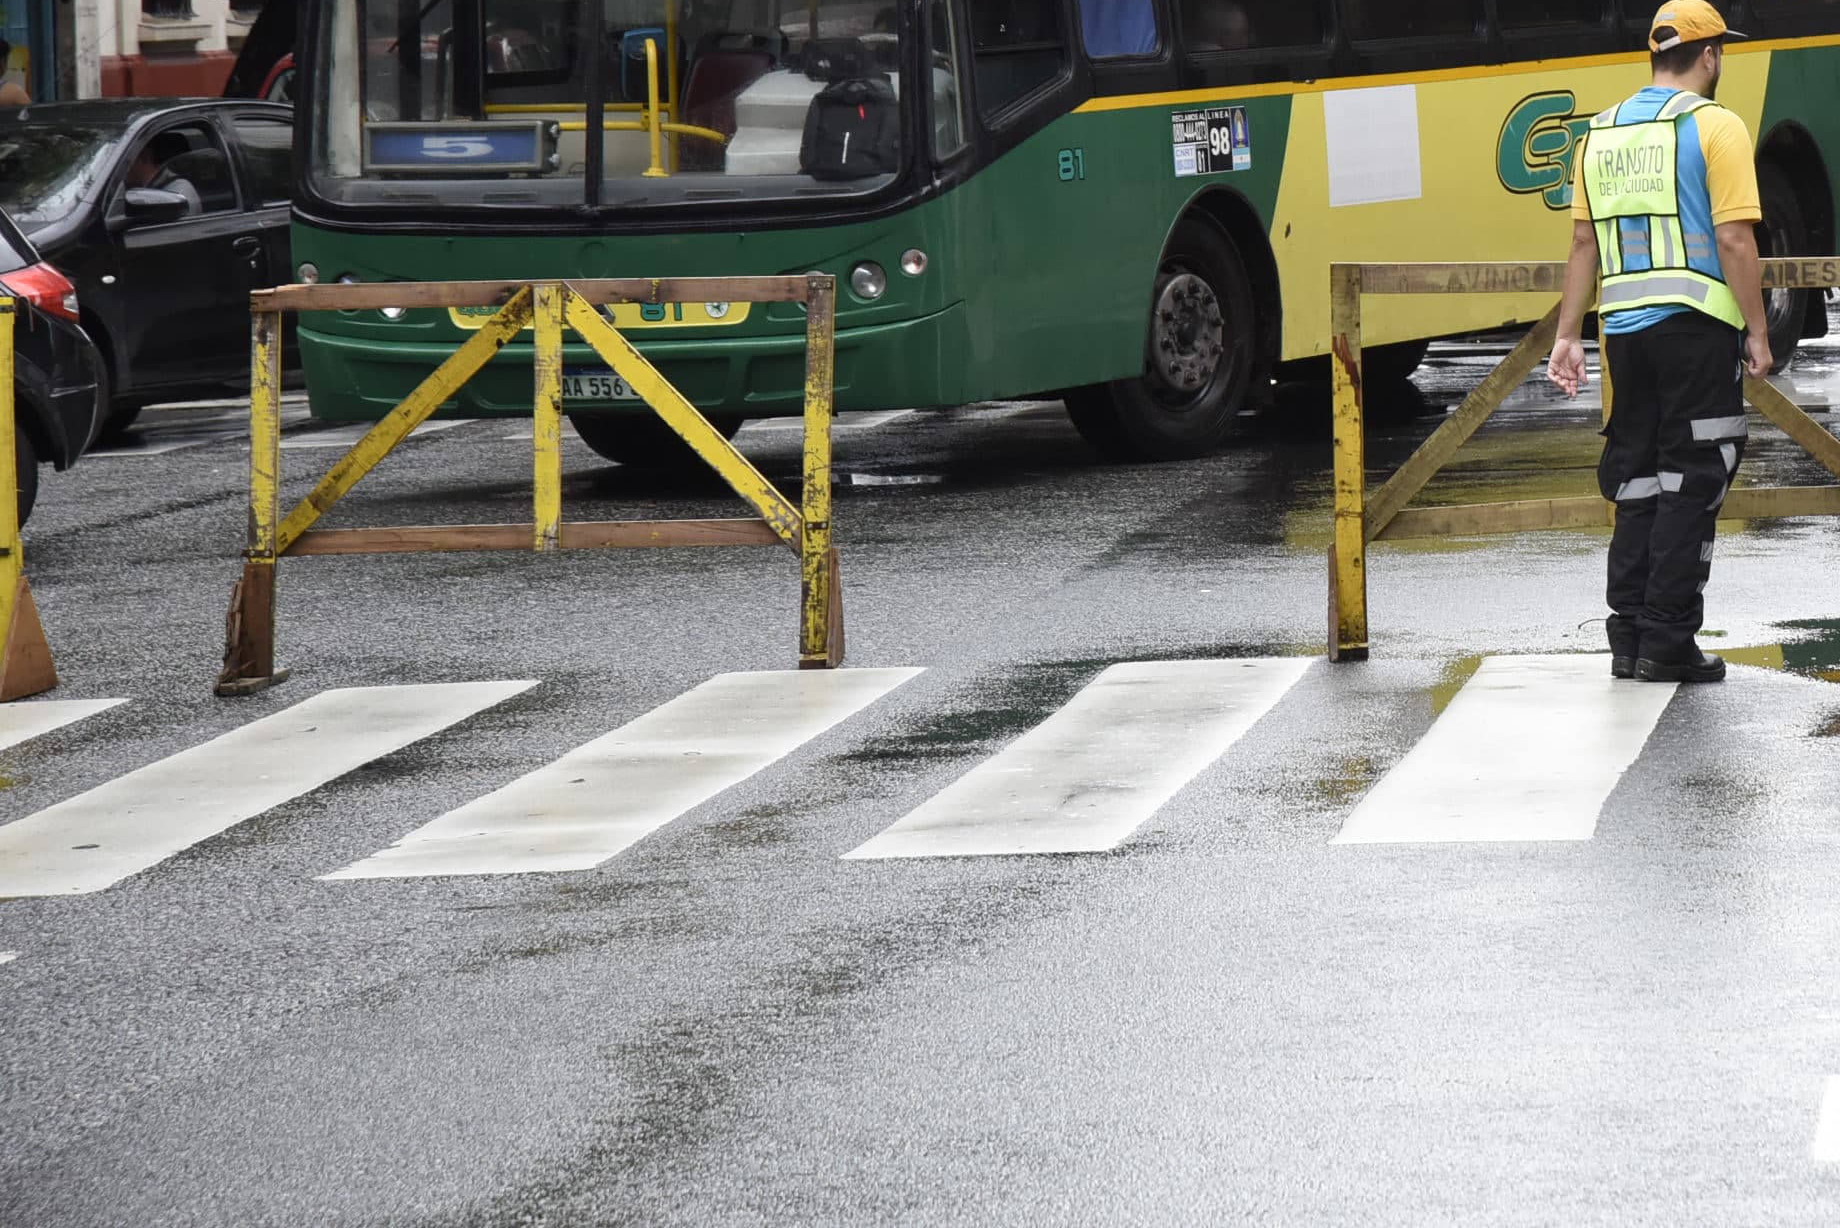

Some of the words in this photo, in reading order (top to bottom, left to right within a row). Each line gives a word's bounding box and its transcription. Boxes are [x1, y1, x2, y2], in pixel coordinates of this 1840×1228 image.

[1207, 110, 1229, 120] LINEA
[420, 136, 494, 158] 5
[1210, 126, 1231, 156] 98
[1058, 148, 1084, 181] 81
[1596, 144, 1664, 178] TRANSITO
[1599, 182, 1612, 196] DE
[1625, 178, 1664, 194] CIUDAD
[1762, 261, 1837, 287] AIRES
[589, 376, 624, 397] 556
